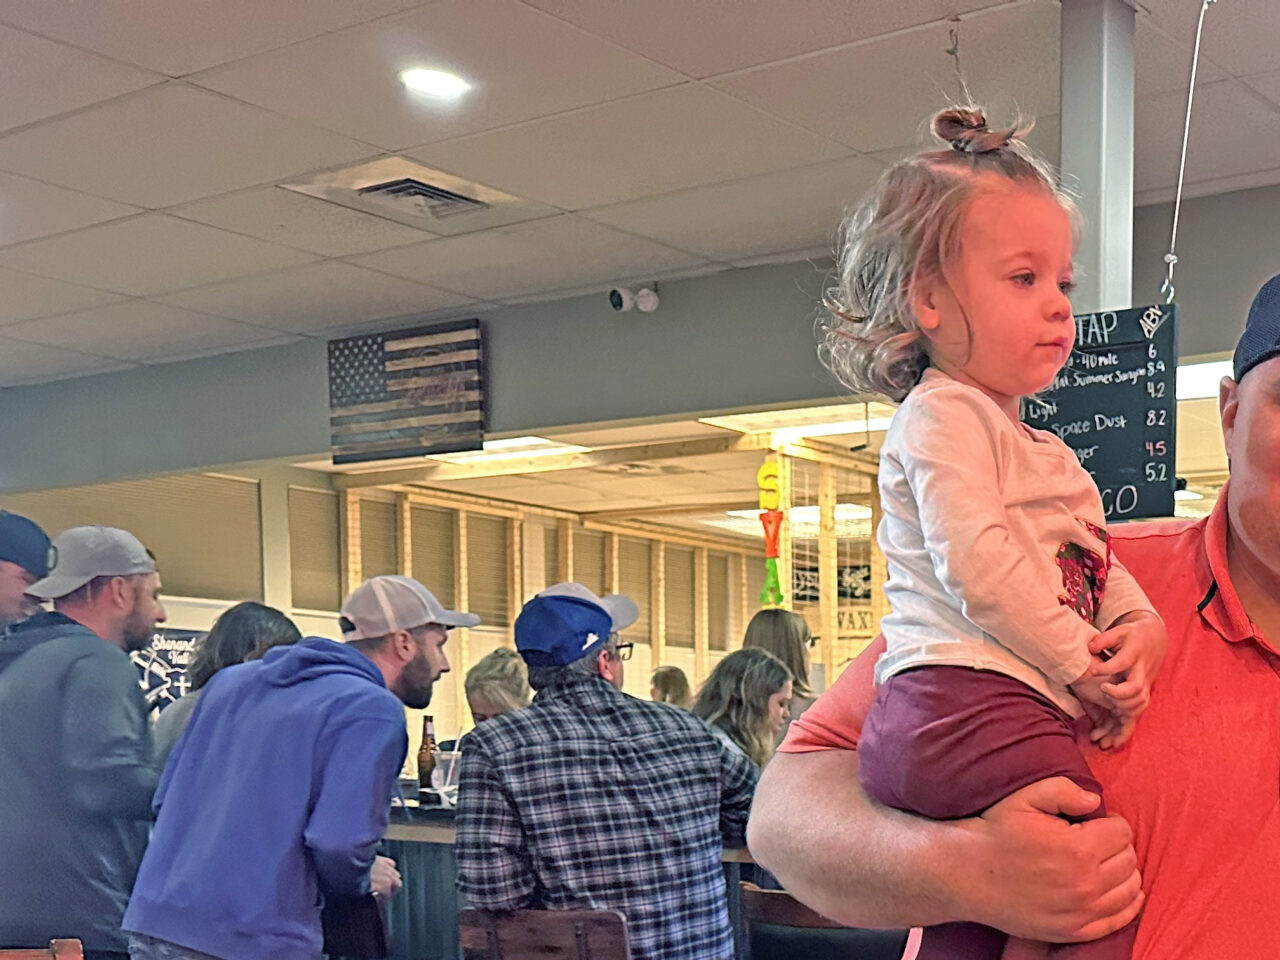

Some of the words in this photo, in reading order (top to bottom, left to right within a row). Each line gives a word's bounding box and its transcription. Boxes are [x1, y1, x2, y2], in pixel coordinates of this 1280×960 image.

[1074, 312, 1118, 346] TAP
[1148, 344, 1157, 359] 6
[1094, 414, 1128, 431] Dust
[152, 633, 197, 651] Shenand
[168, 650, 190, 665] Vall
